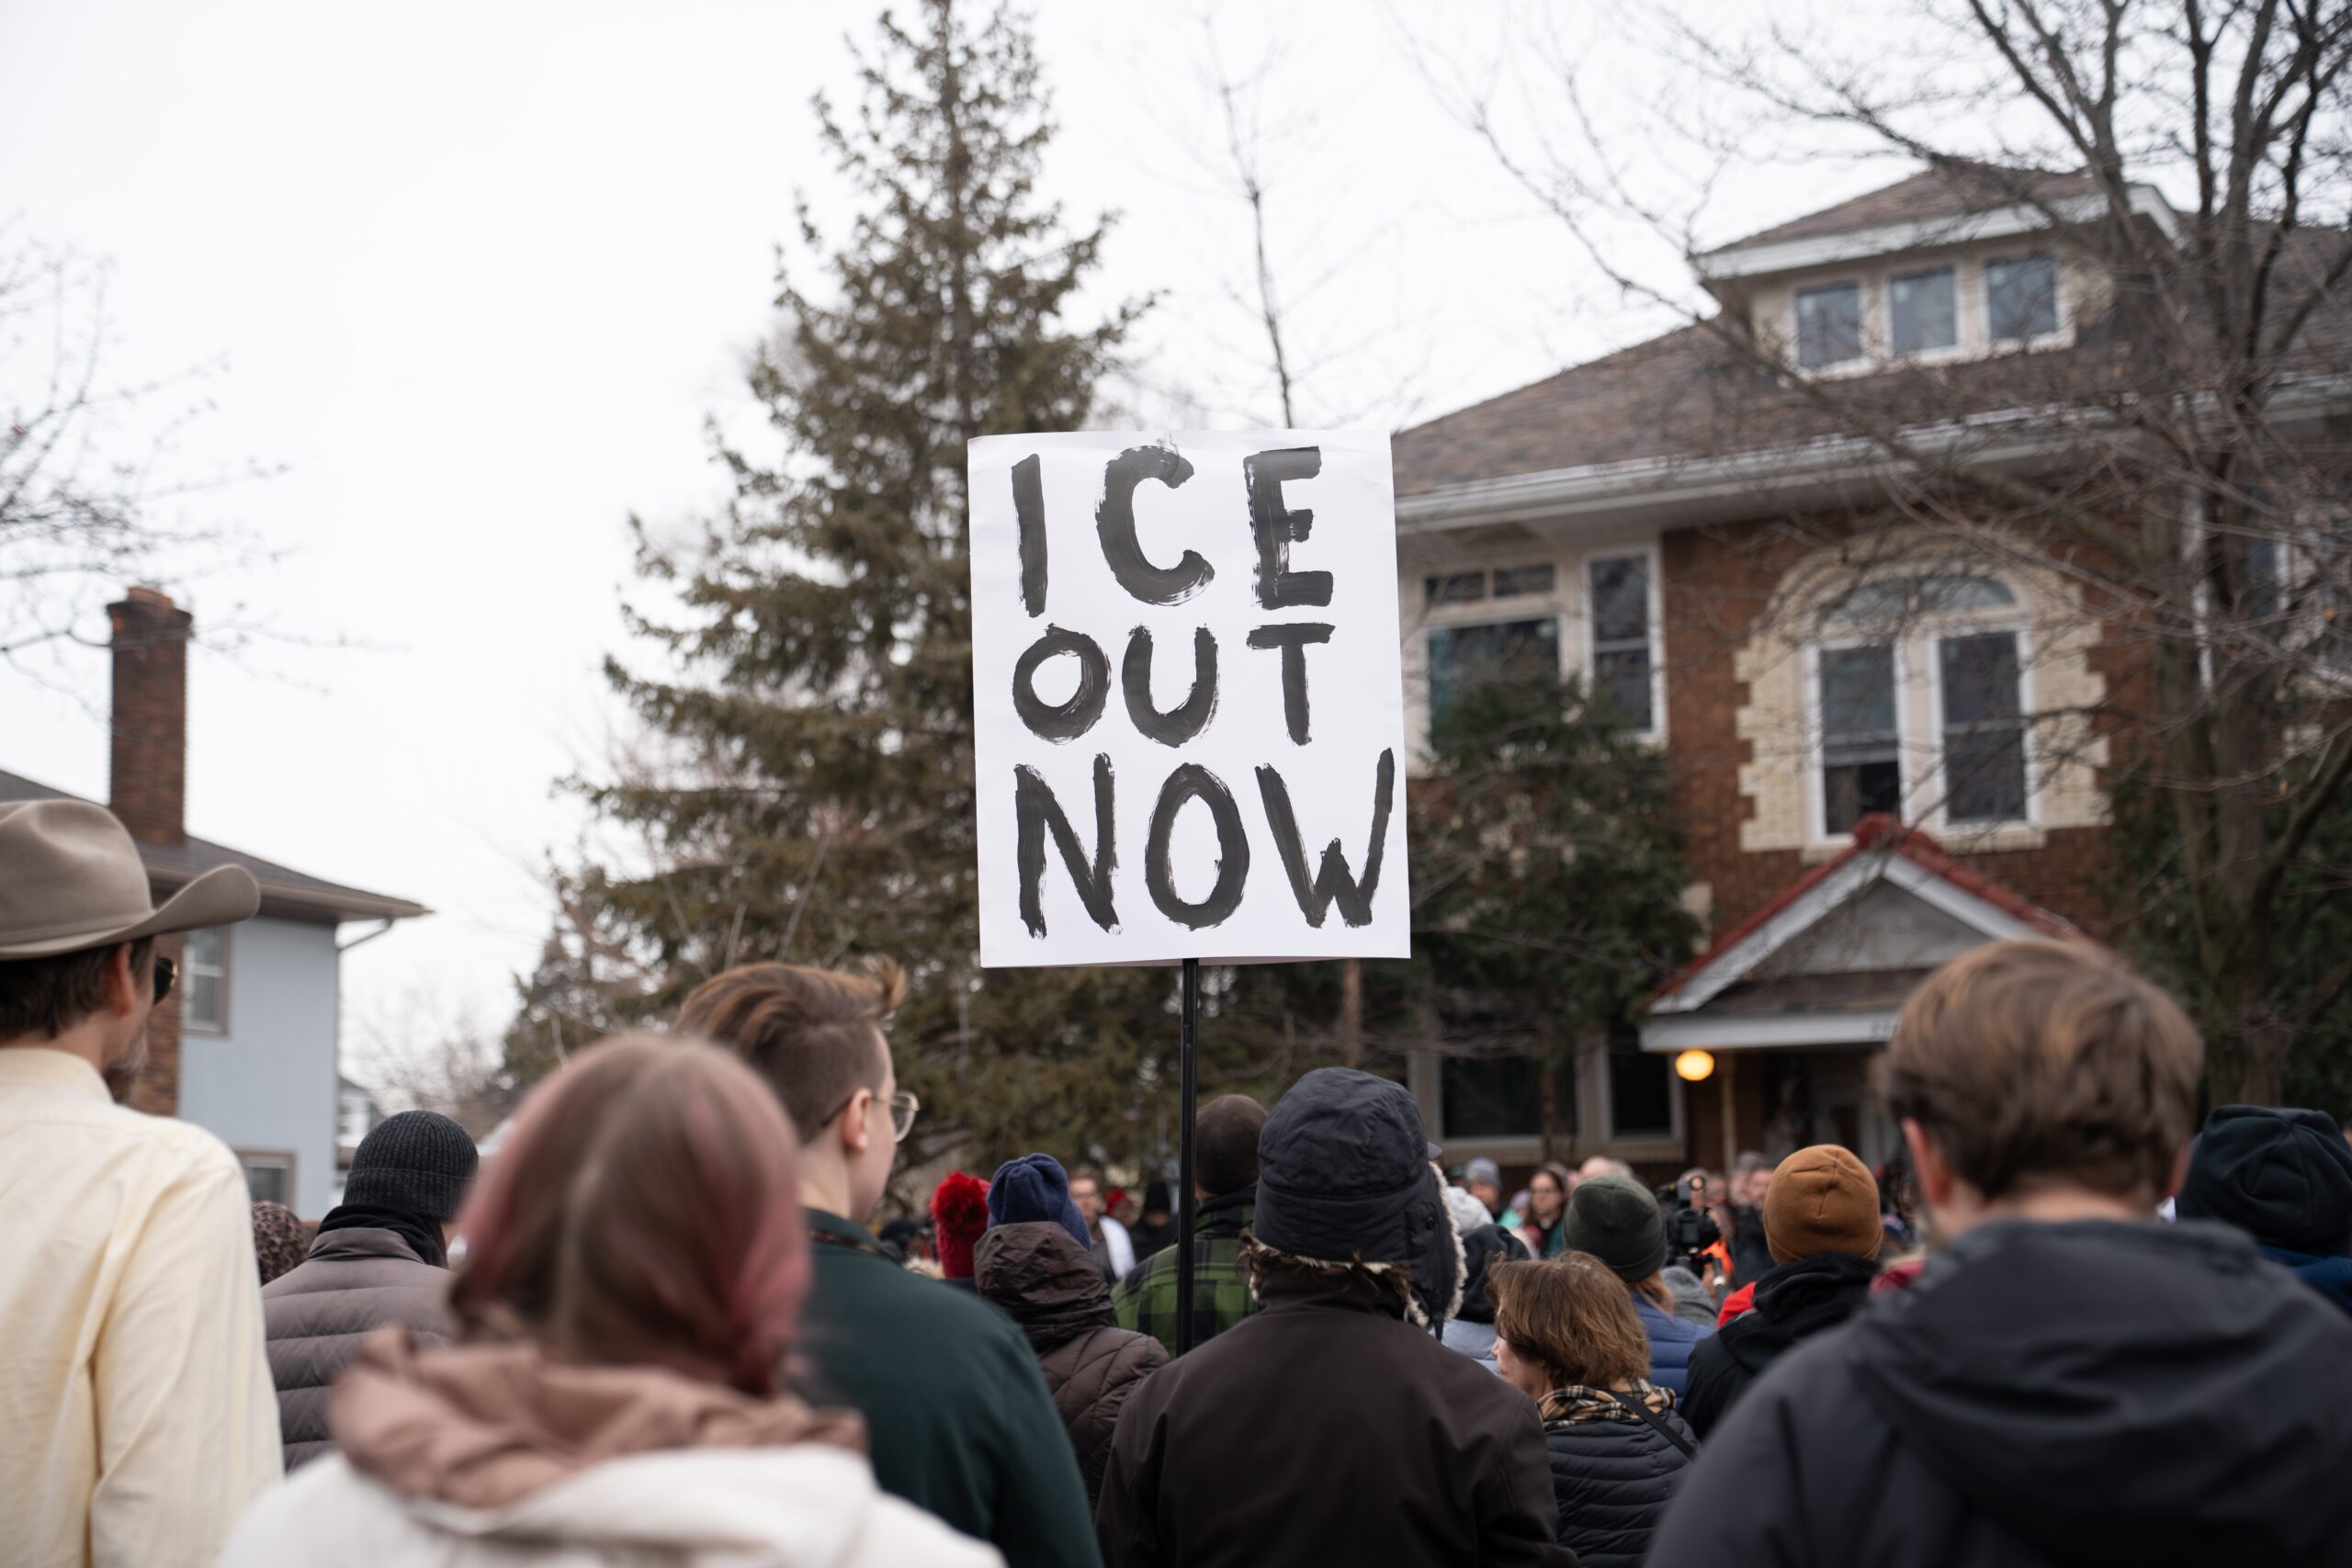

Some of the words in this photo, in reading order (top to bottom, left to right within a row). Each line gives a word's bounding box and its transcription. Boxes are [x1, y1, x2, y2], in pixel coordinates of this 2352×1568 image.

[1012, 444, 1334, 617] ICE
[1012, 623, 1336, 748] OUT
[1013, 748, 1395, 939] NOW
